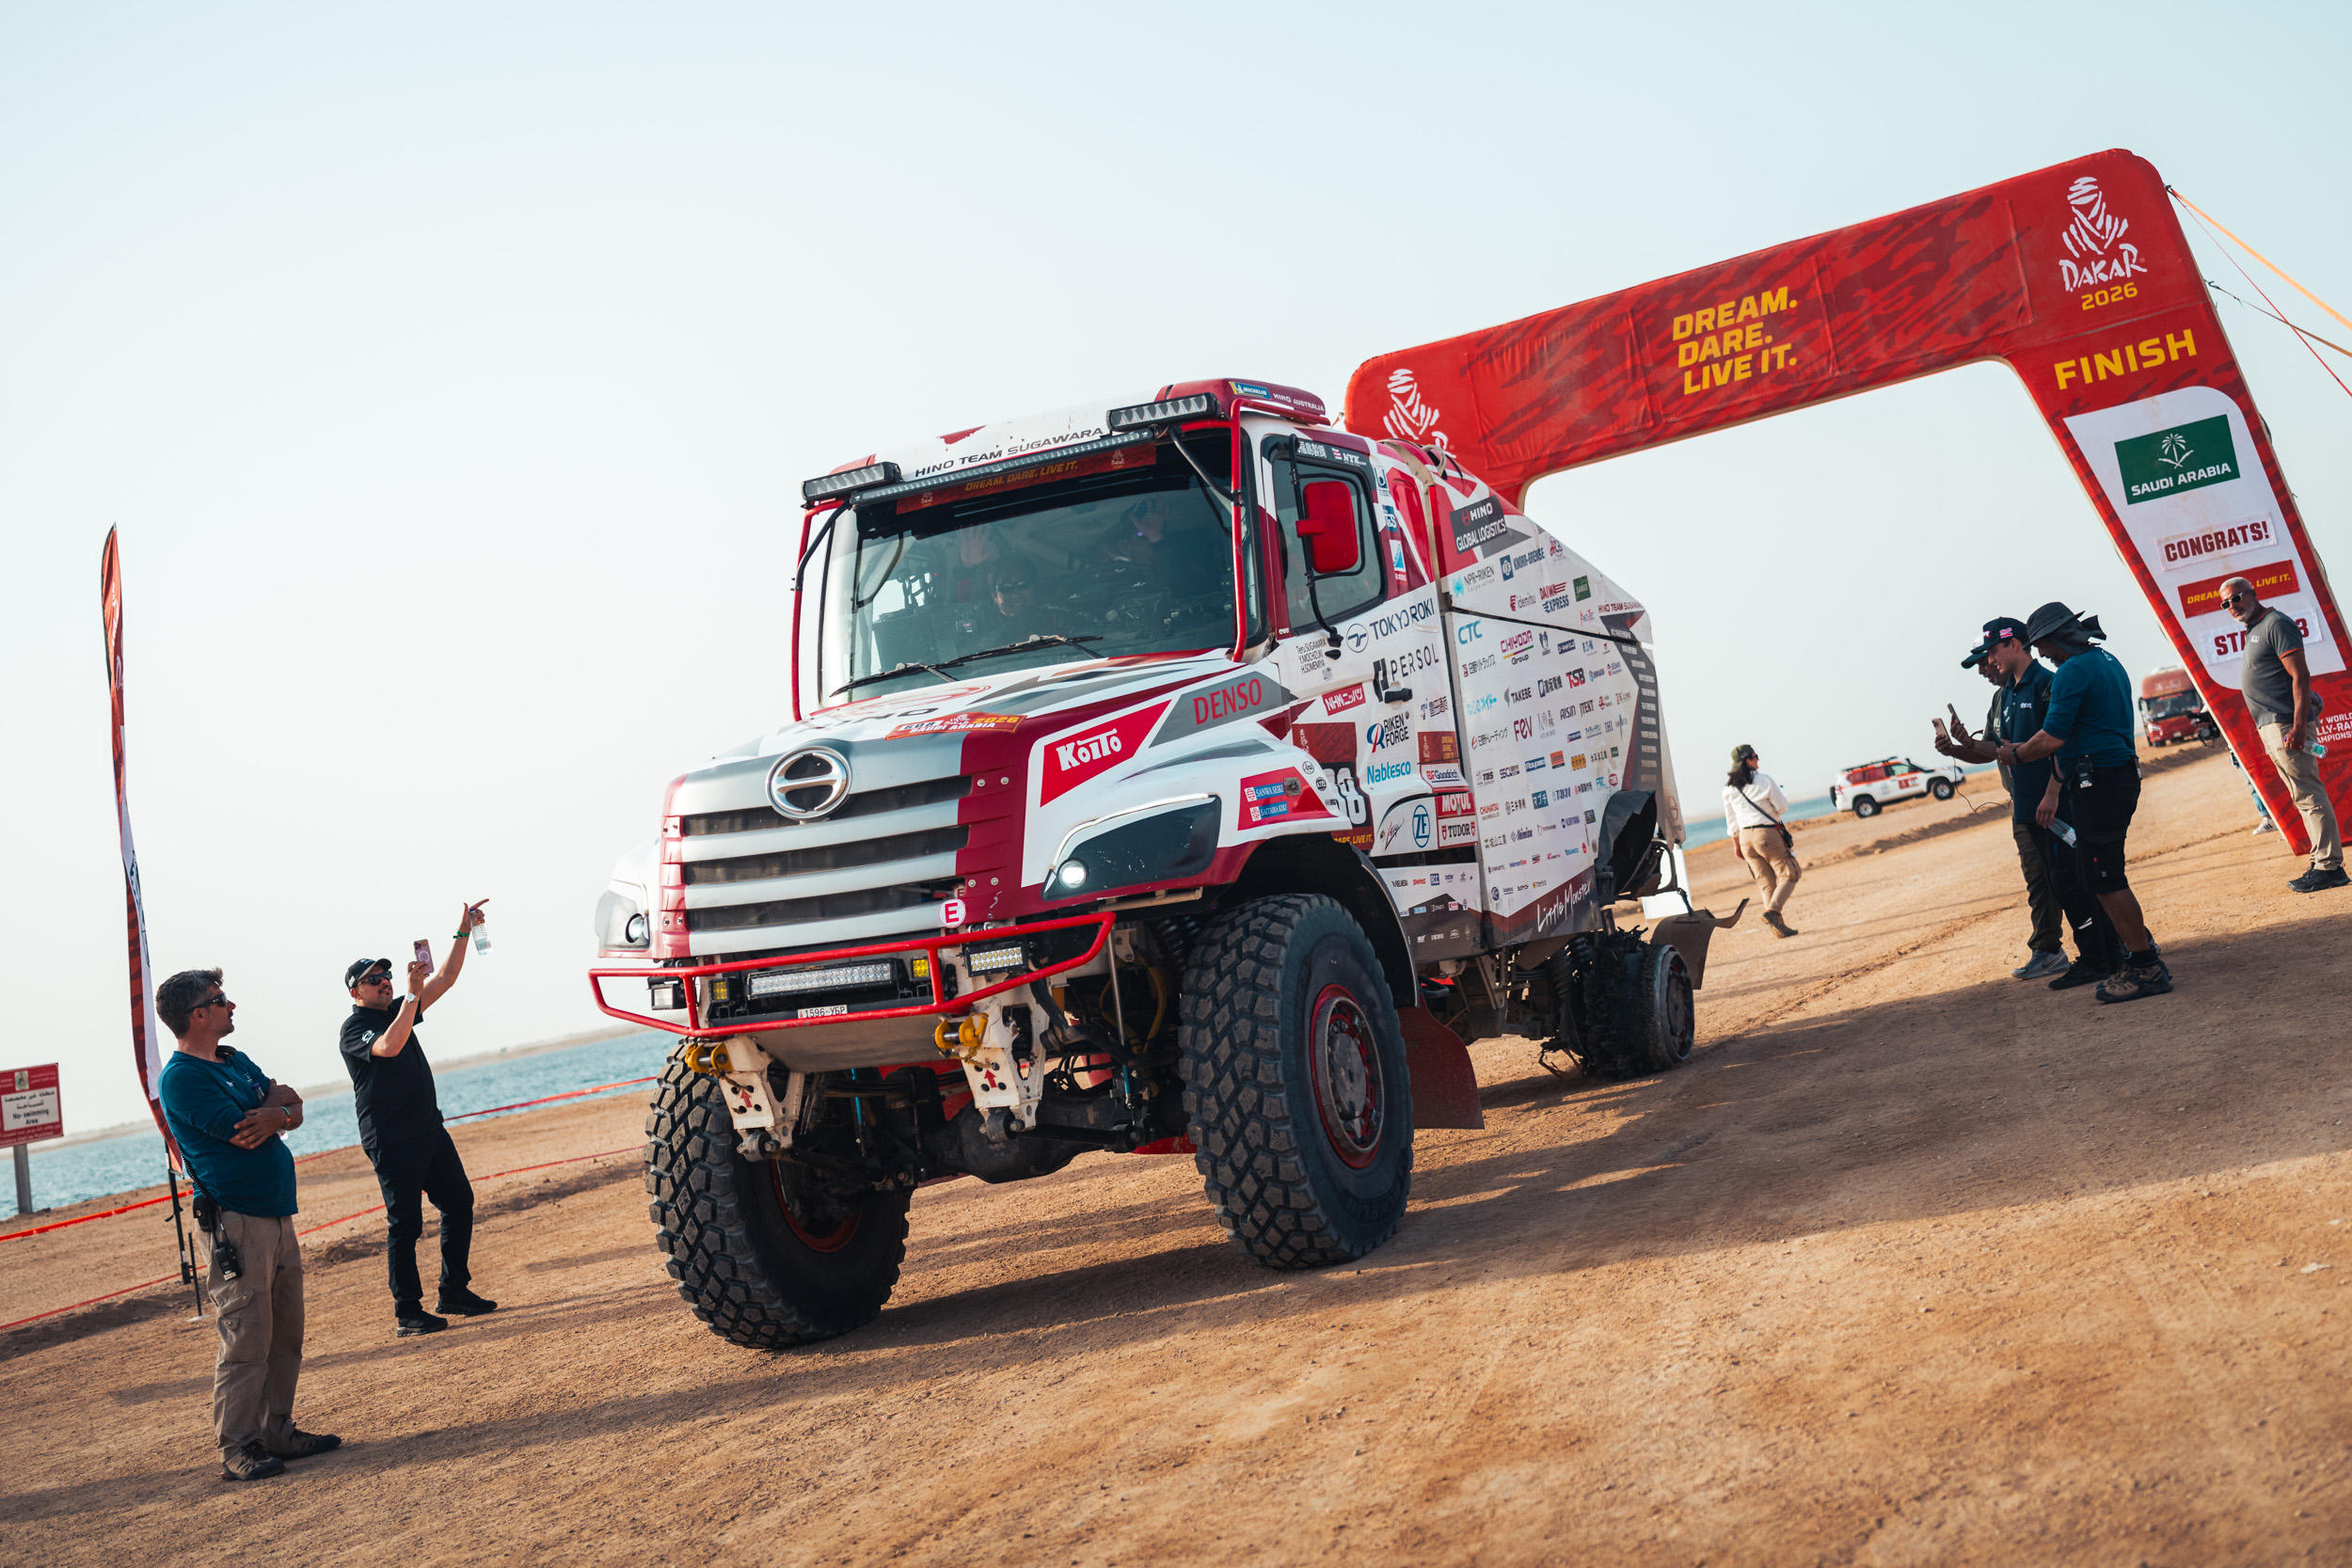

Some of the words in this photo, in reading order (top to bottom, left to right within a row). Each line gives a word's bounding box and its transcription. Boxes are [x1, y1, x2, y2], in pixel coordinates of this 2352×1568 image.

[2058, 243, 2147, 293] DAKAR
[2081, 282, 2138, 310] 2026
[1672, 286, 1798, 341] DREAM.
[1677, 322, 1773, 368] DARE.
[1684, 354, 1753, 395] LIVE
[1761, 343, 1798, 374] IT.
[2054, 328, 2198, 390] FINISH
[1243, 387, 1267, 396] MICHELIN
[1273, 393, 1292, 404] HINO
[1293, 399, 1325, 411] AUSTRALIA
[914, 460, 955, 478] HINO
[959, 450, 1003, 467] TEAM
[1008, 427, 1104, 456] SUGAWARA
[1343, 452, 1359, 464] NYK
[964, 478, 1006, 492] DREAM.
[1008, 470, 1039, 483] DARE.
[1040, 465, 1063, 476] LIVE
[2131, 476, 2174, 497] SAUDI
[2178, 462, 2232, 485] ARABIA
[1470, 502, 1494, 521] HINO
[1455, 532, 1479, 552] GLOBAL
[1478, 518, 1506, 541] LOGISTICS
[2164, 520, 2270, 562] CONGRATS!
[2256, 577, 2278, 588] LIVE
[2278, 573, 2291, 583] IT.
[1543, 594, 1570, 613] EXPRESS
[1370, 611, 1409, 641] TOKYO
[1411, 597, 1435, 622] ROKI
[1458, 620, 1483, 644] CTC
[1500, 629, 1534, 653] CHIYODA
[2214, 631, 2247, 657] STA
[1391, 643, 1439, 682] PERSOL
[1511, 654, 1530, 665] Group
[1565, 667, 1585, 689] TSB
[1193, 678, 1263, 725] DENSO
[1510, 687, 1533, 705] TAKEBE
[910, 724, 948, 734] SAUDI
[948, 722, 996, 731] ARABIA
[972, 716, 1020, 724] 2026
[1383, 713, 1405, 734] RIKEN
[1385, 727, 1409, 748] FORGE
[1367, 759, 1411, 785] Nabtesco
[1255, 785, 1272, 799] SANWA
[1441, 793, 1471, 814] MOTUL
[1413, 813, 1430, 839] ZF
[1448, 823, 1471, 838] TUDOR
[944, 902, 960, 923] E
[804, 1007, 825, 1019] 1596
